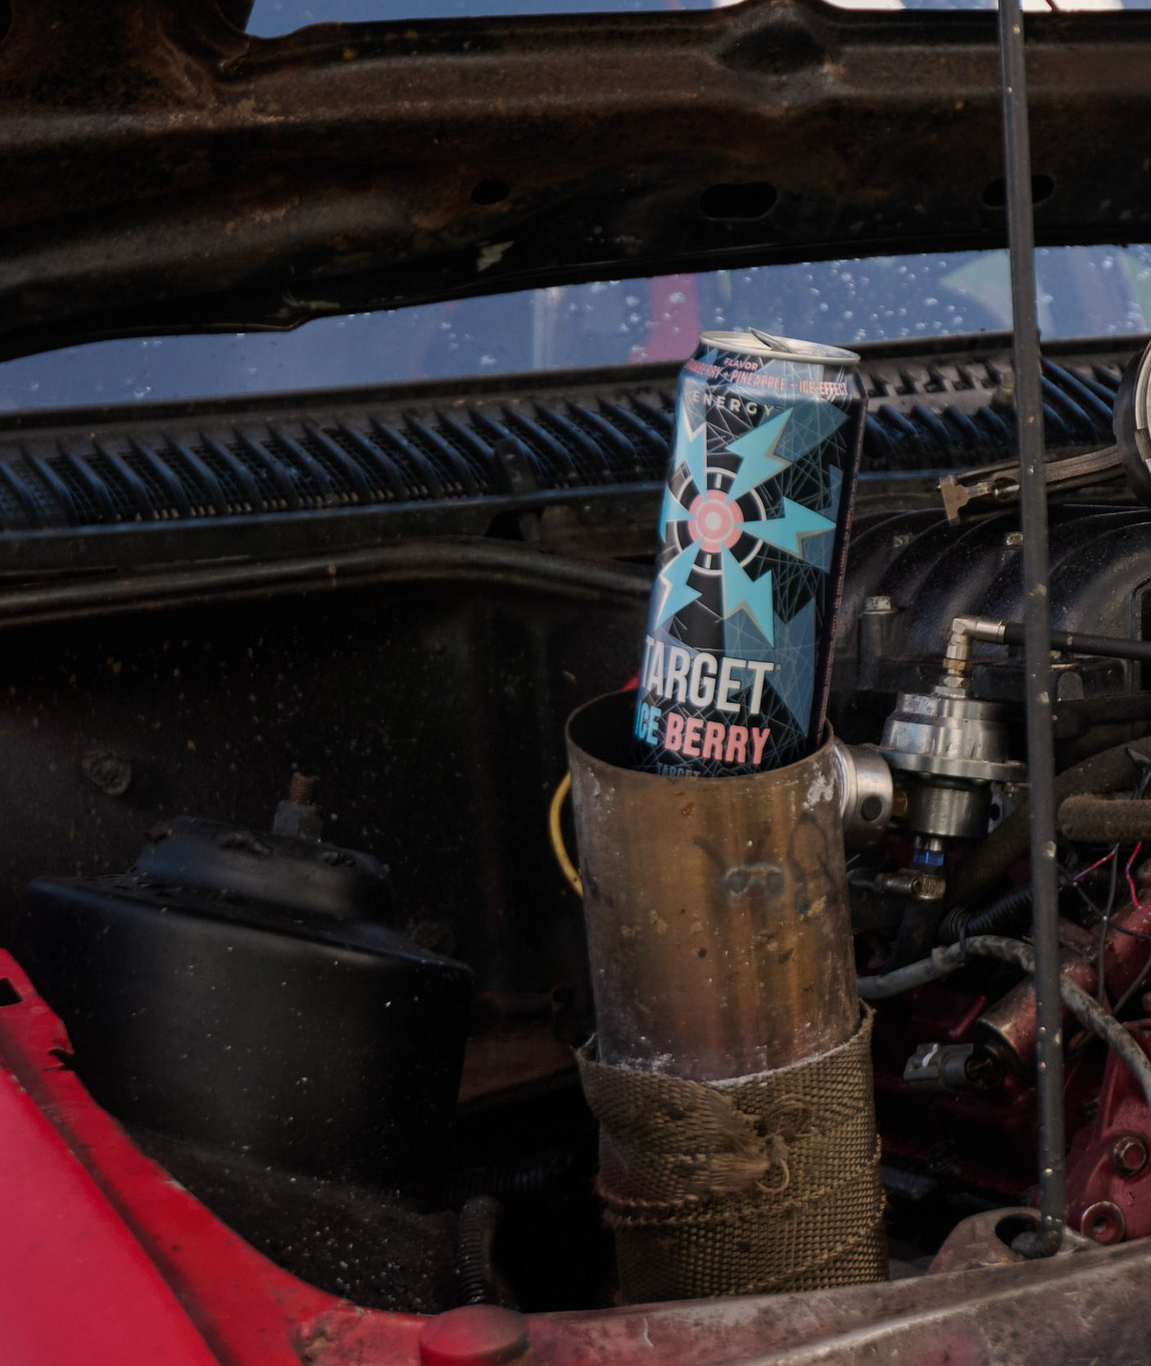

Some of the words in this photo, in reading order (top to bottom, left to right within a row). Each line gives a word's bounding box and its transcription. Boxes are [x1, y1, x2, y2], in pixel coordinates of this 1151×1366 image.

[723, 357, 759, 371] FLAVOR
[730, 370, 786, 390] PINEAPPLE
[692, 390, 776, 417] ENERGY
[643, 636, 775, 715] TARGET
[635, 700, 661, 745] ICE
[664, 712, 771, 765] BERRY
